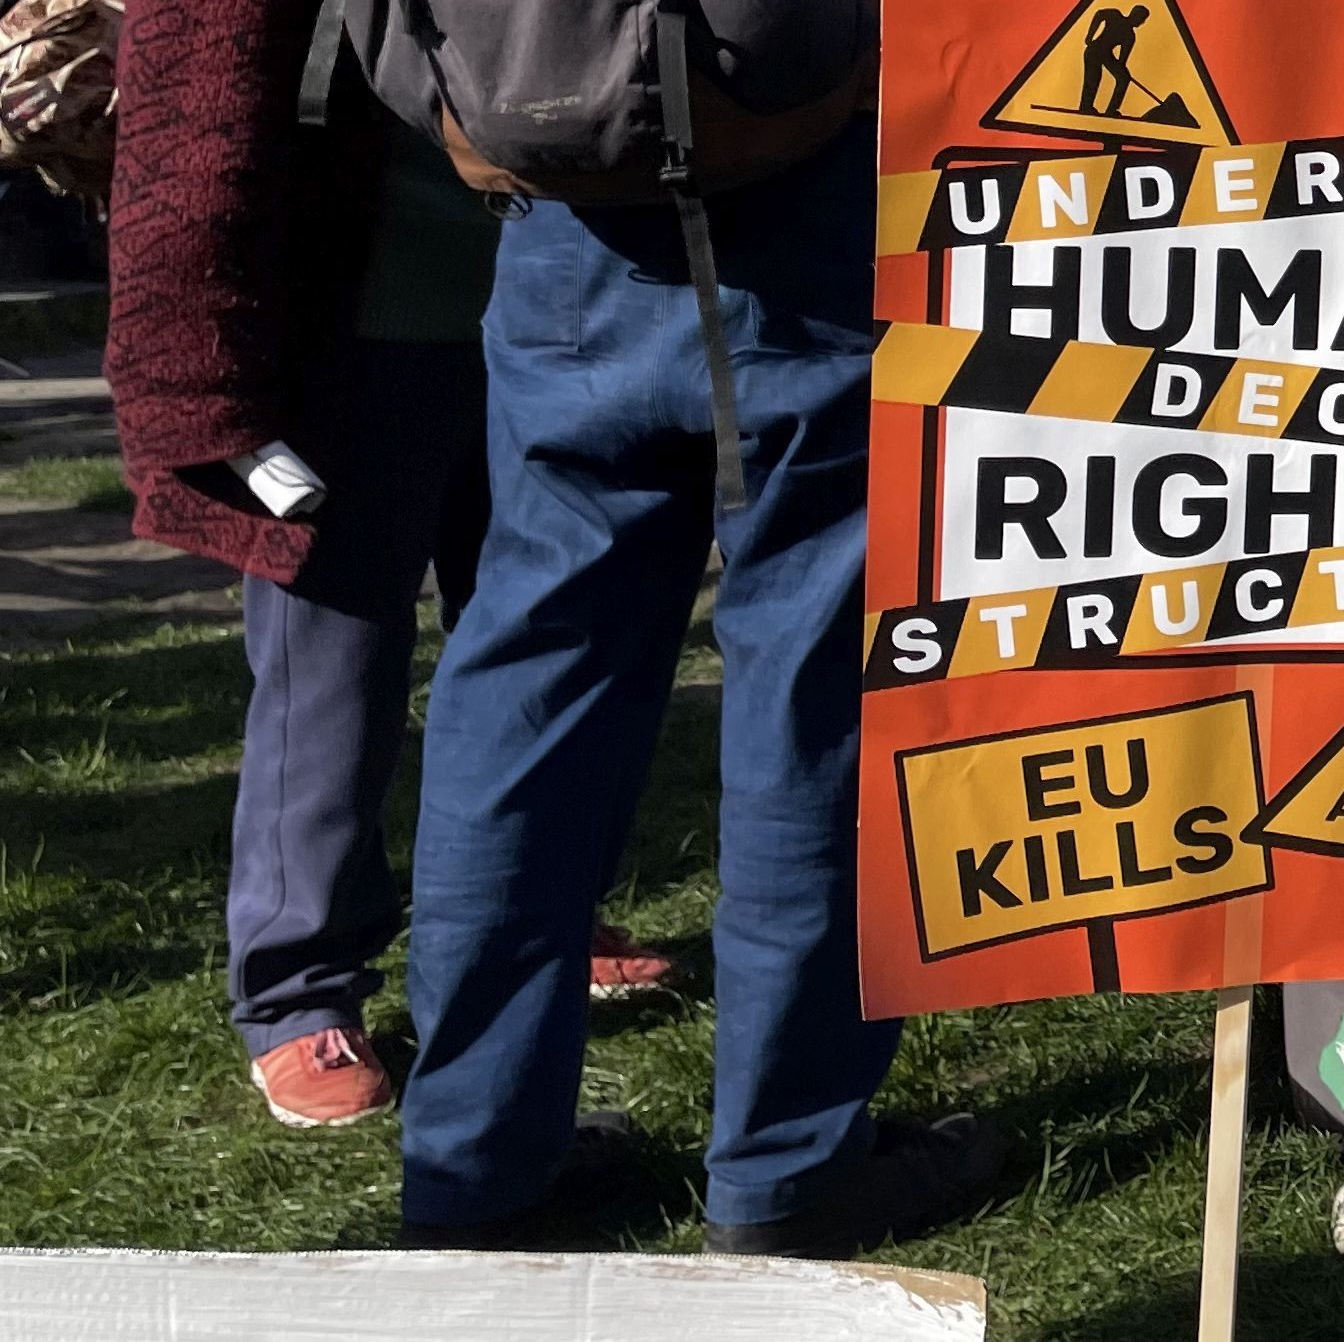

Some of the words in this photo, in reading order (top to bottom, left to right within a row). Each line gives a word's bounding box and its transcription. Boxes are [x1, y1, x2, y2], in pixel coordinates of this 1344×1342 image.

[948, 150, 1344, 236] UNDER
[1022, 738, 1151, 823] EU
[955, 804, 1235, 919] KILLS
